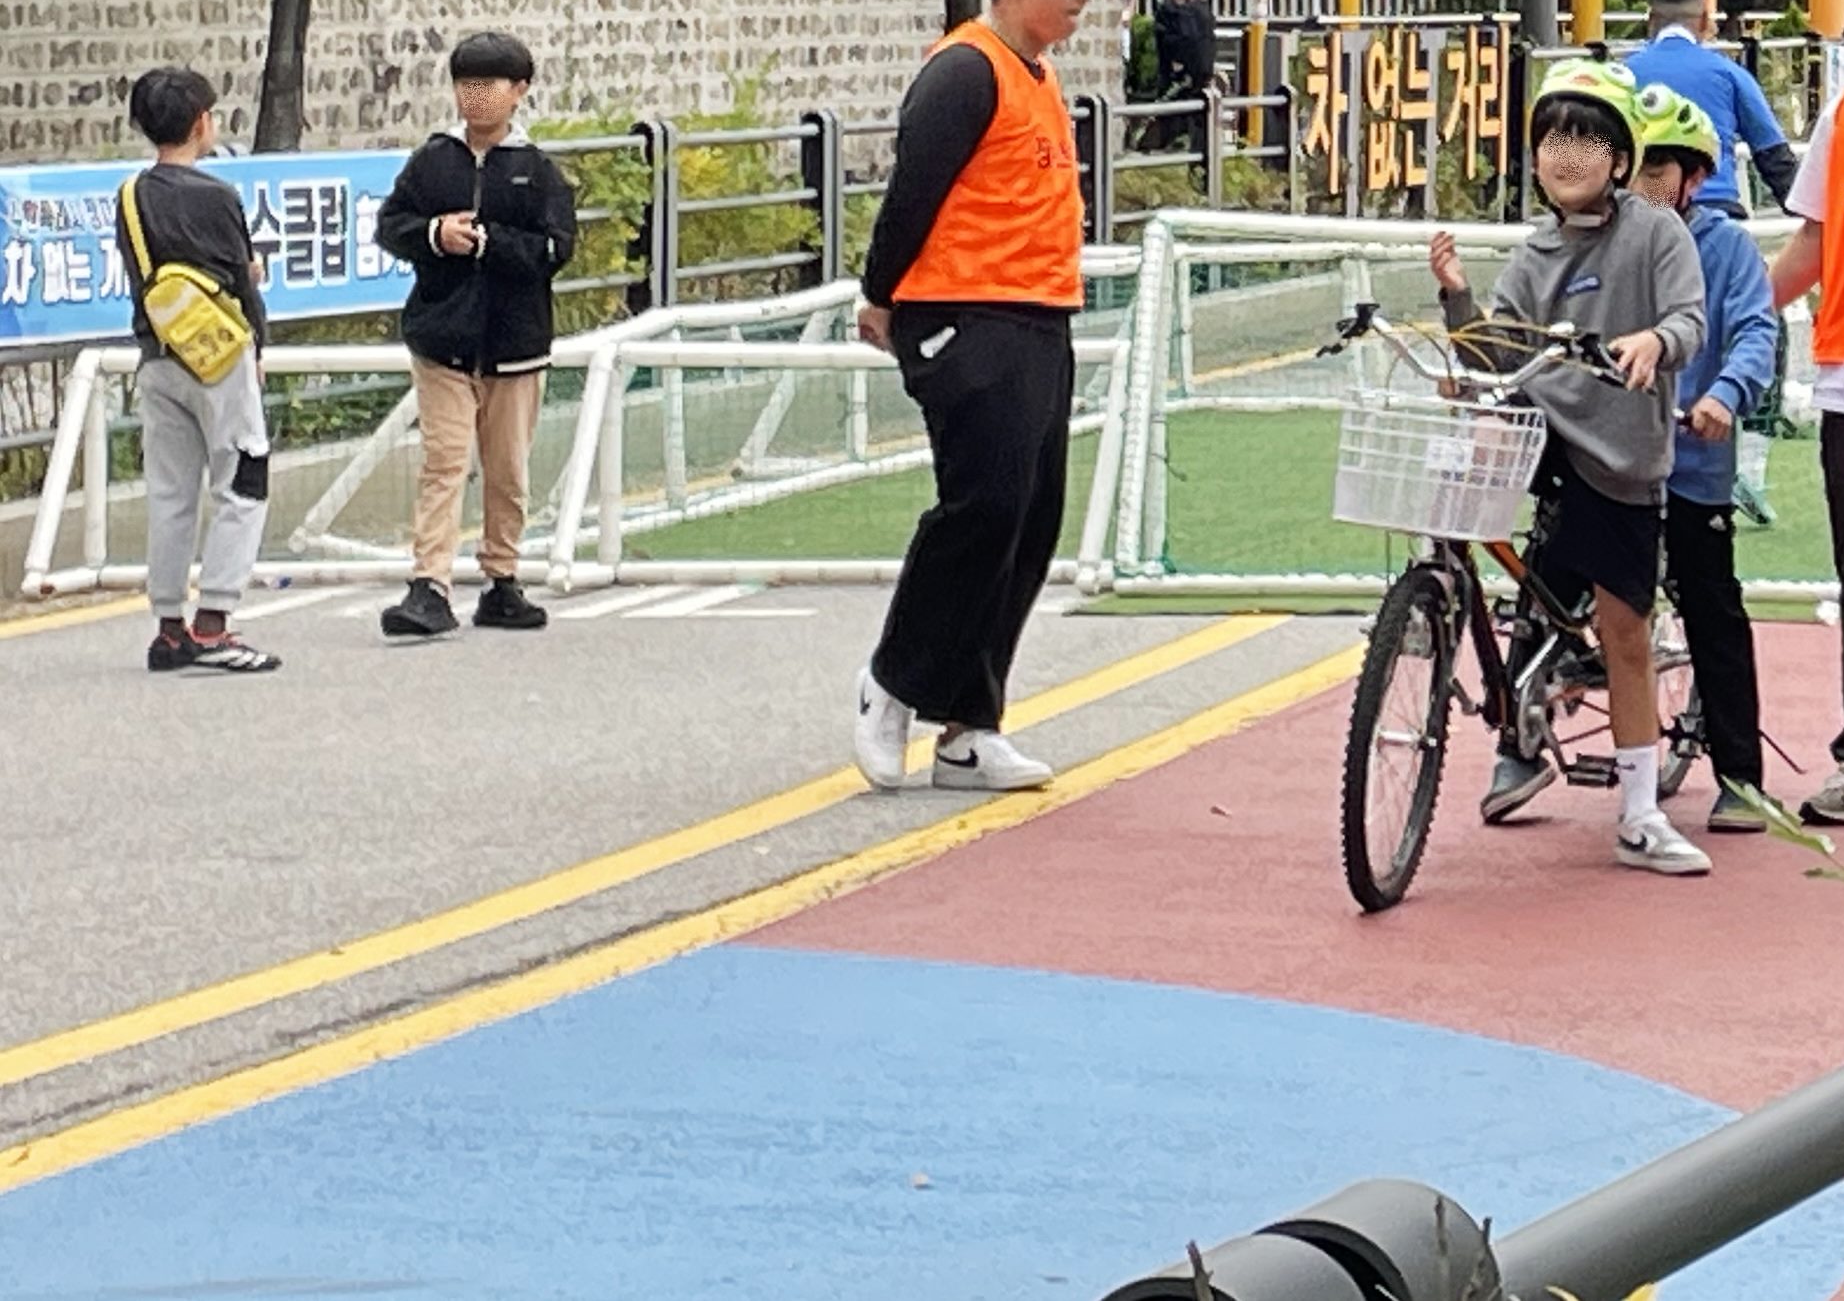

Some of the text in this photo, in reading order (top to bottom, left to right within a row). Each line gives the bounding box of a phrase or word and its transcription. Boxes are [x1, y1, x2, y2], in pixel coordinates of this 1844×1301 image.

[1302, 24, 1509, 195] 차 없는 거리
[3, 239, 36, 305] 차
[42, 239, 92, 303] 없는
